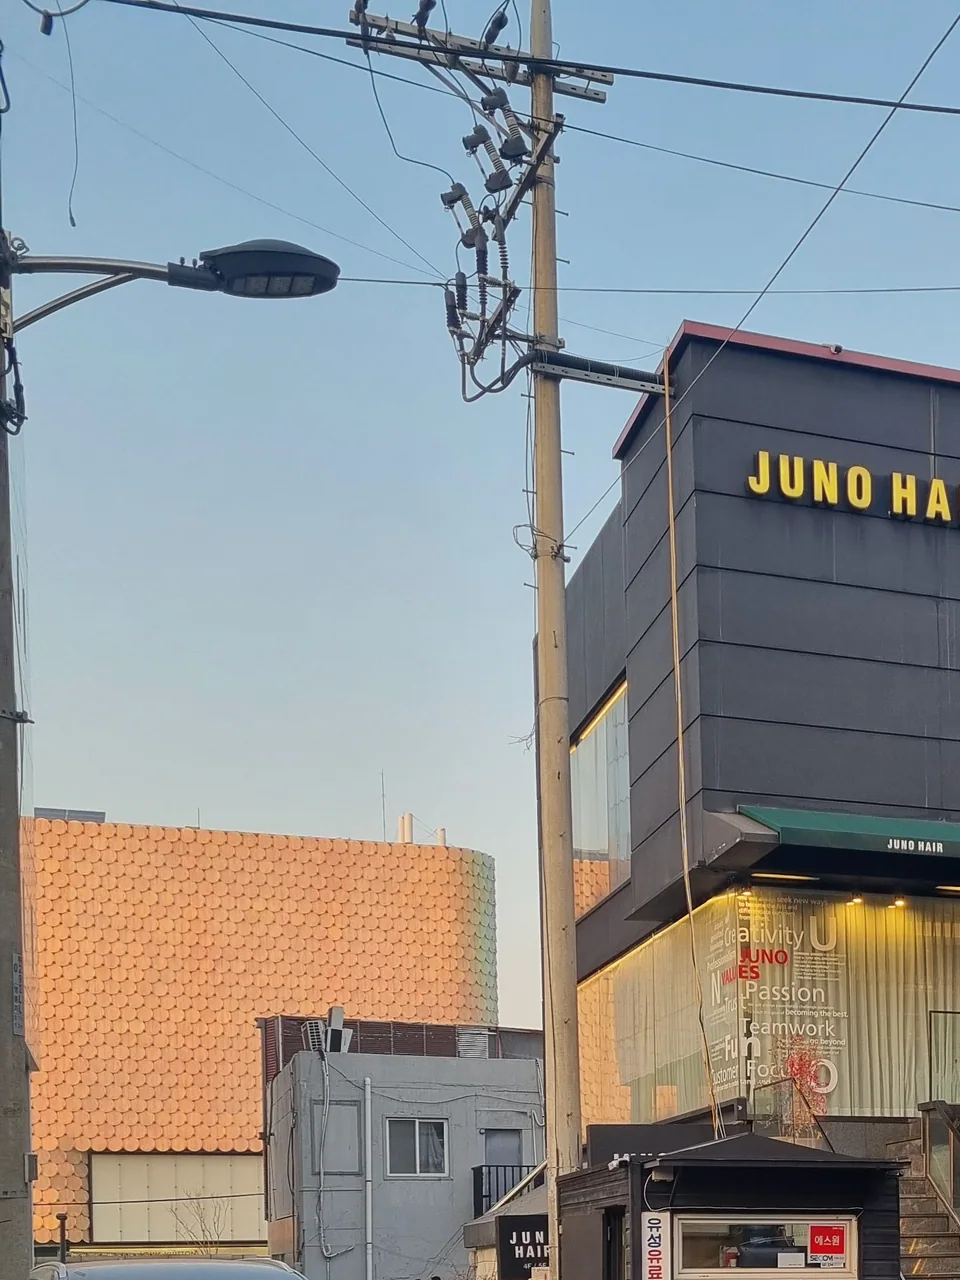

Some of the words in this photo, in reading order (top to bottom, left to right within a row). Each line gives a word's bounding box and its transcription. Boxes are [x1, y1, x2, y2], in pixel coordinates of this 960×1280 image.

[747, 450, 873, 511] JUNO
[887, 838, 915, 851] JUNO
[917, 841, 944, 853] HAIR
[740, 947, 788, 965] JUNO
[745, 980, 825, 1003] Passion
[786, 1009, 819, 1018] becoming
[820, 1010, 831, 1018] the
[740, 1017, 836, 1037] Teamwork
[819, 1038, 846, 1047] beyond
[746, 1059, 792, 1078] Focu
[509, 1230, 545, 1245] JUN
[814, 1235, 840, 1246] 에스원
[809, 1254, 834, 1262] SECOM
